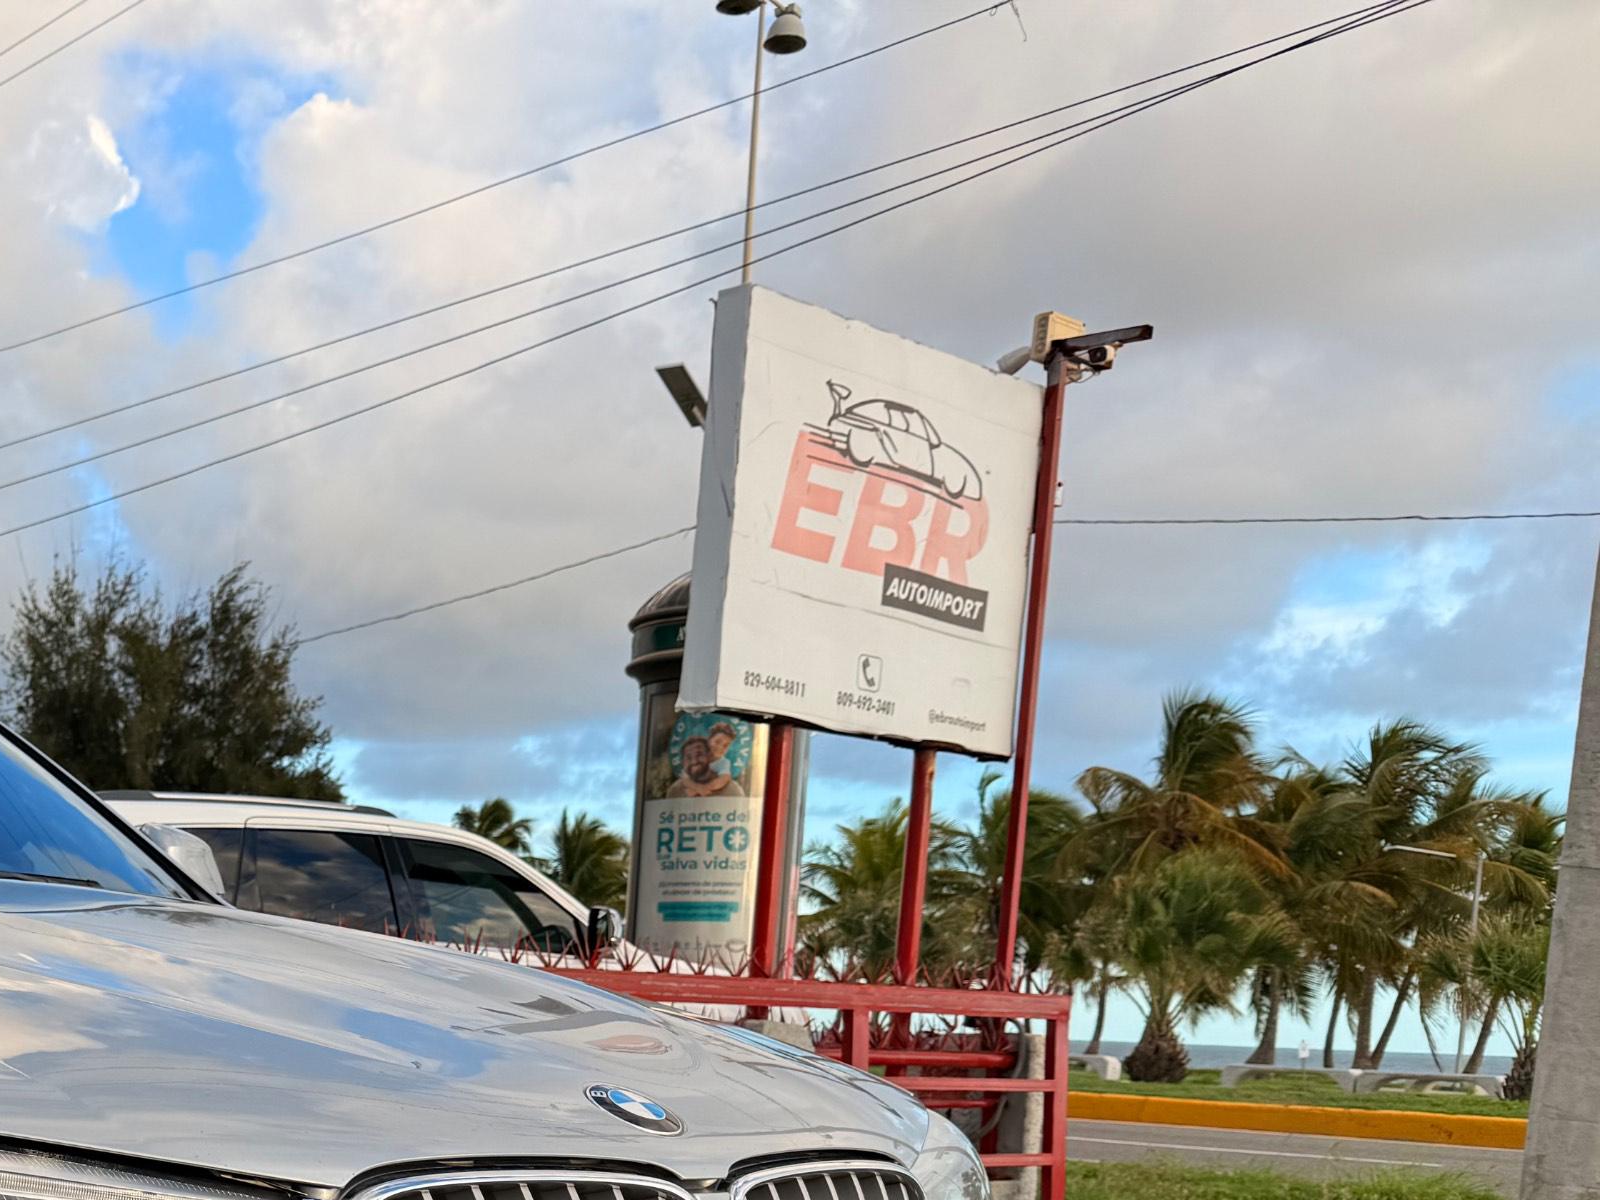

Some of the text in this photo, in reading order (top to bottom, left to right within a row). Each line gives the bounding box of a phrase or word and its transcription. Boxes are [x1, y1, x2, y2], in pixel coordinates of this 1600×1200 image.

[771, 431, 989, 587] EBR
[886, 577, 984, 620] AUTOIMPORT
[744, 671, 806, 698] 829-604-8811
[836, 691, 896, 717] 809-692-3401
[678, 811, 721, 825] parte
[656, 826, 750, 853] RETO
[660, 856, 747, 871] salva vidas
